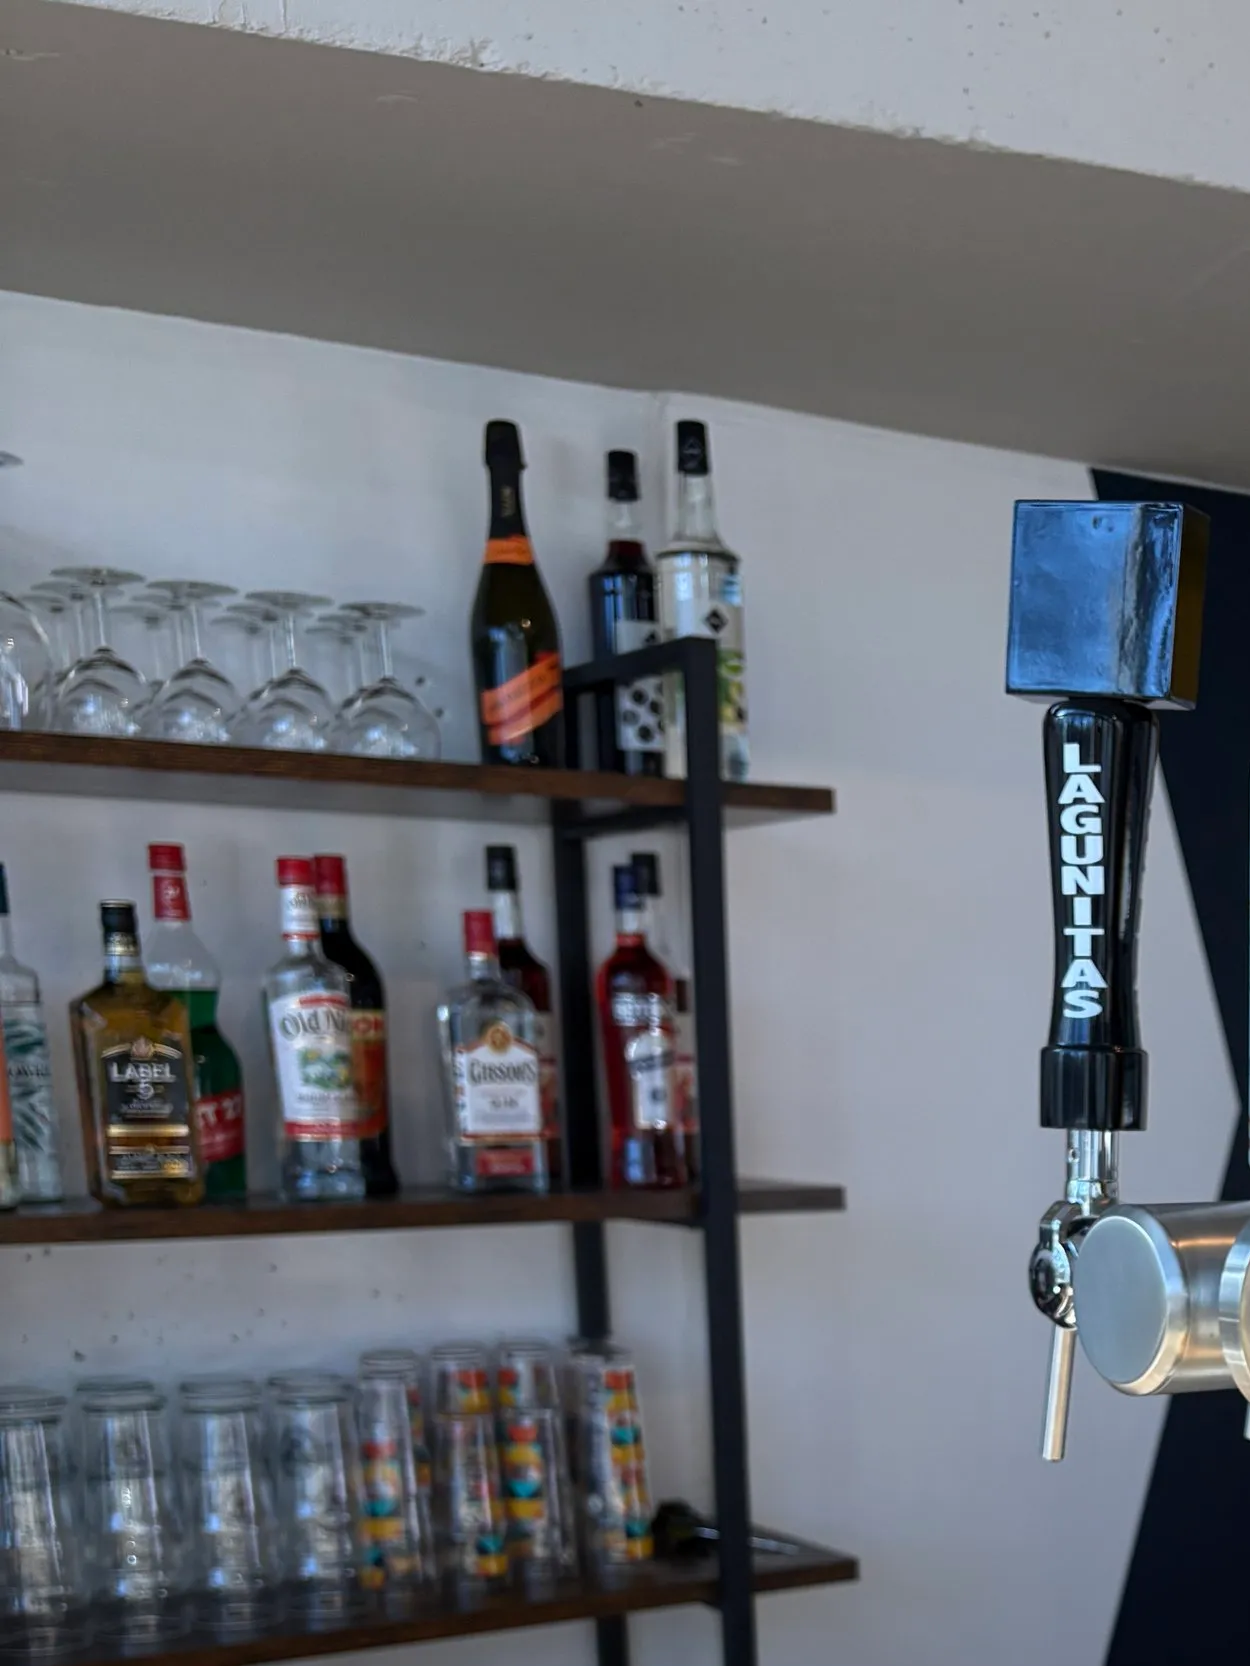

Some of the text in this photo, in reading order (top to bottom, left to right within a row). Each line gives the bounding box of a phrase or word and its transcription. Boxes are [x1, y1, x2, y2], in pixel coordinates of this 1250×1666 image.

[1057, 743, 1108, 1019] LAGUNITAS
[281, 1010, 320, 1040] Old
[111, 1061, 176, 1082] LABEL
